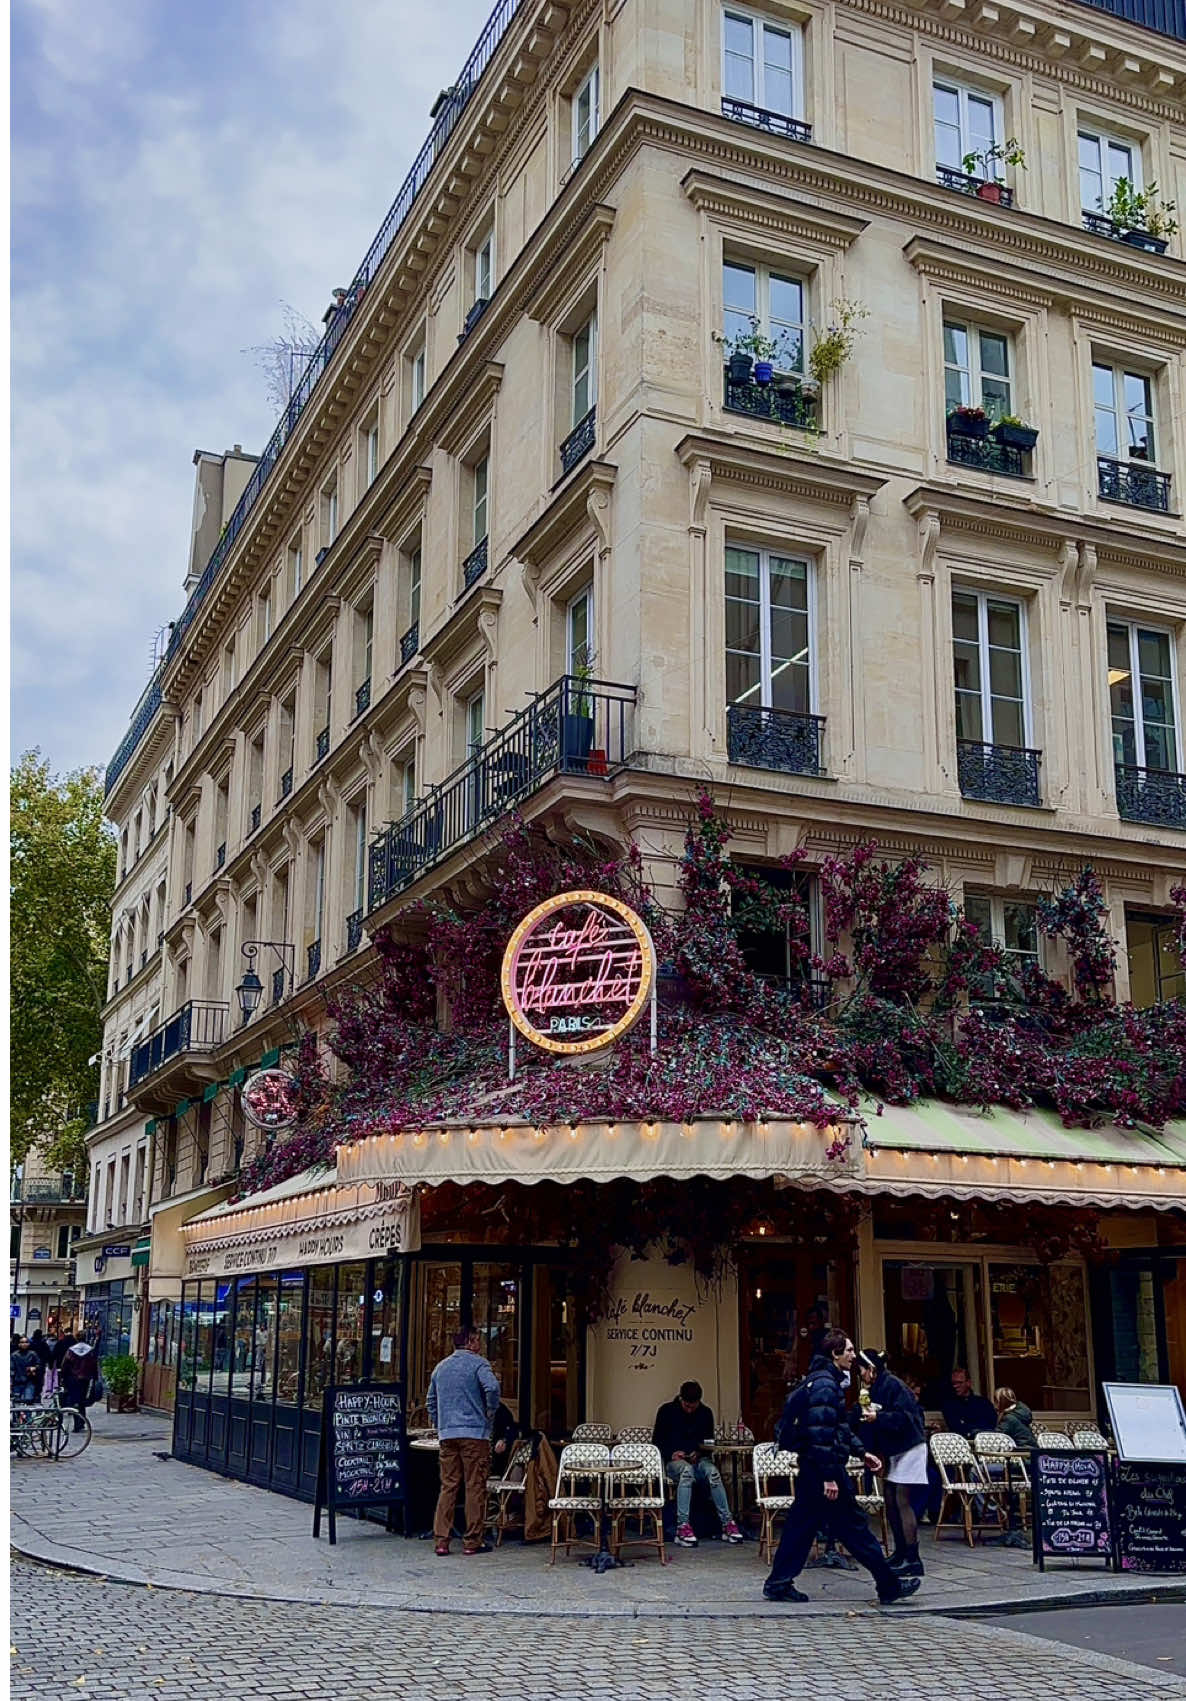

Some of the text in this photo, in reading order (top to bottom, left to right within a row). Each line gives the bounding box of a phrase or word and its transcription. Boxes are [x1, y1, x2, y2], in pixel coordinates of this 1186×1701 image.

[550, 1016, 593, 1033] PARIS
[105, 1247, 129, 1255] CCF
[632, 1292, 696, 1327] blanchet
[607, 1328, 693, 1342] SERVICE CONTINU
